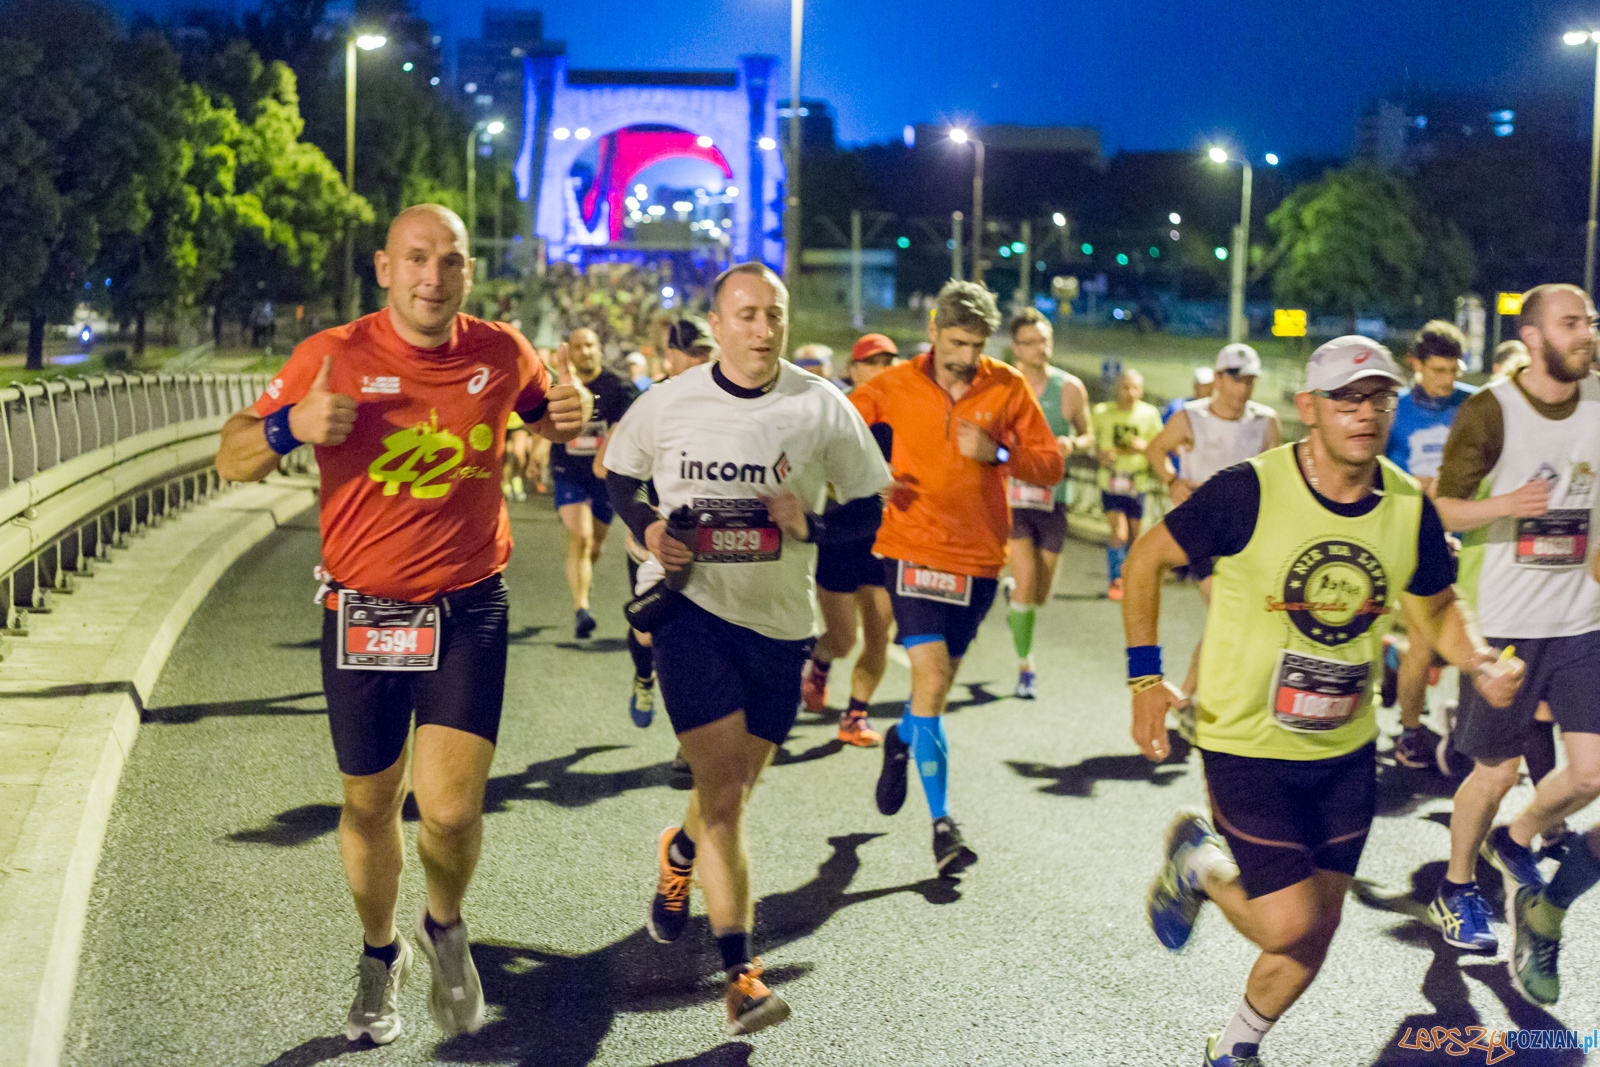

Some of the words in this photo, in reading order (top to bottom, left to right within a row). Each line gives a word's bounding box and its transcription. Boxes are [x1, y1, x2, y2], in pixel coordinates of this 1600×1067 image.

[368, 425, 465, 499] 42
[680, 450, 766, 485] incom
[712, 530, 761, 552] 9929
[915, 568, 957, 592] 10725
[365, 629, 419, 653] 2594
